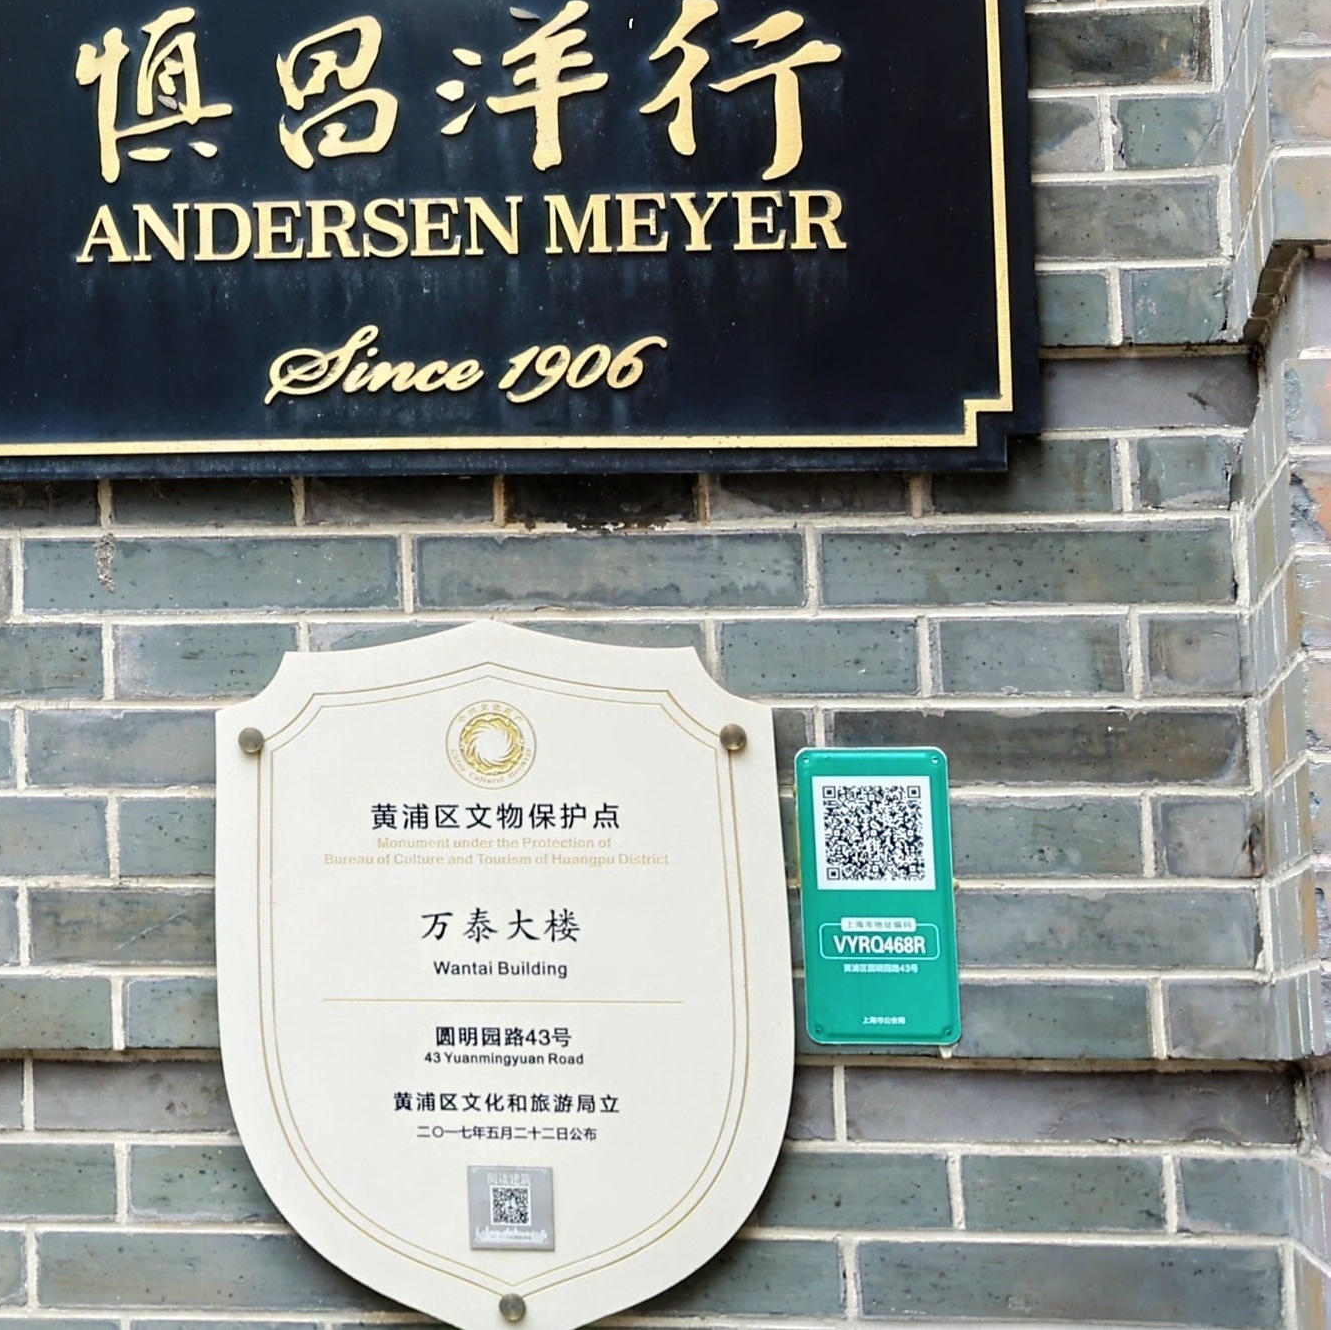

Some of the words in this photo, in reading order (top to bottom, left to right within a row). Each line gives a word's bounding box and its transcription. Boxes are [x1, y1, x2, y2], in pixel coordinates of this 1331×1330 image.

[77, 196, 521, 263] ANDERSEN
[544, 191, 847, 254] MEYER
[264, 325, 483, 404] Since
[498, 336, 667, 404] 1906
[371, 802, 619, 829] 黄浦区文物保护点
[377, 837, 449, 848] Monument
[453, 837, 493, 848] under
[496, 837, 518, 848] the
[522, 837, 594, 848] Protection
[597, 837, 611, 848] of
[324, 853, 373, 865] Bureau
[376, 853, 390, 864] of
[393, 853, 444, 864] Culture
[447, 853, 473, 864] and
[476, 853, 531, 864] Tourism
[534, 853, 548, 864] of
[551, 853, 614, 867] Huangpu
[618, 853, 668, 865] District
[421, 907, 579, 942] 万泰大楼
[833, 935, 925, 953] VYRQ468R
[433, 961, 492, 974] Wantai
[497, 961, 567, 978] Building
[435, 1026, 571, 1047] 圆明园路43号
[424, 1051, 440, 1062] 43
[444, 1052, 544, 1066] Yuanmingyuan
[548, 1052, 583, 1064] Road
[393, 1091, 618, 1112] 黄浦区文化和旅游局立
